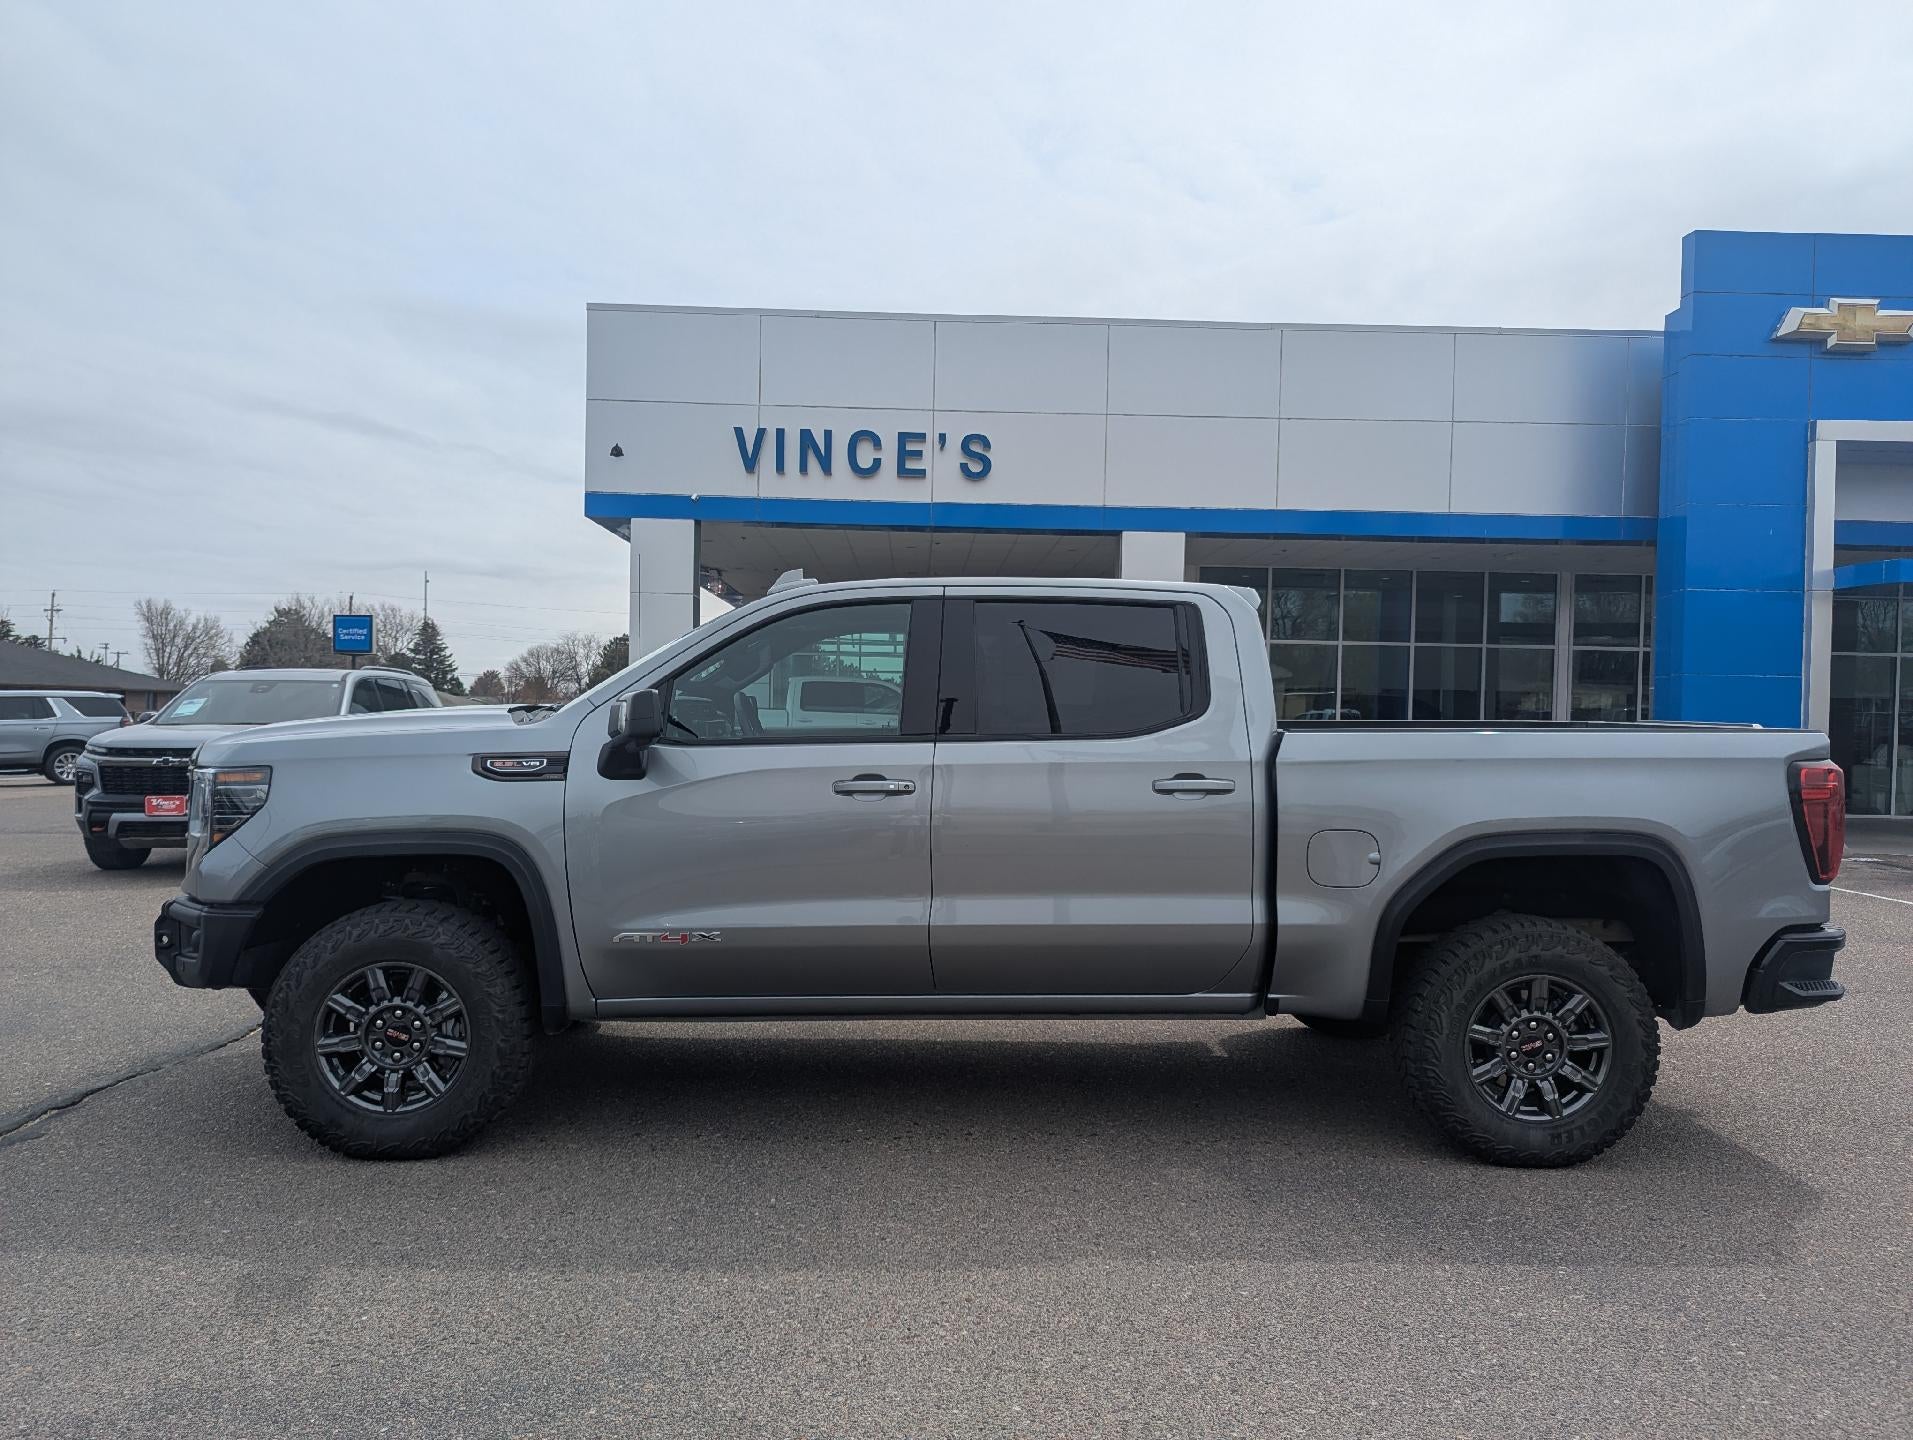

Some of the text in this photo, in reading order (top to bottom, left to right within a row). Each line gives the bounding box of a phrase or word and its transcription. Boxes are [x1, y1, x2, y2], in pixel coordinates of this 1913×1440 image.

[733, 426, 993, 481] VINCE'S
[338, 627, 367, 635] Certified
[612, 930, 721, 945] AT4X
